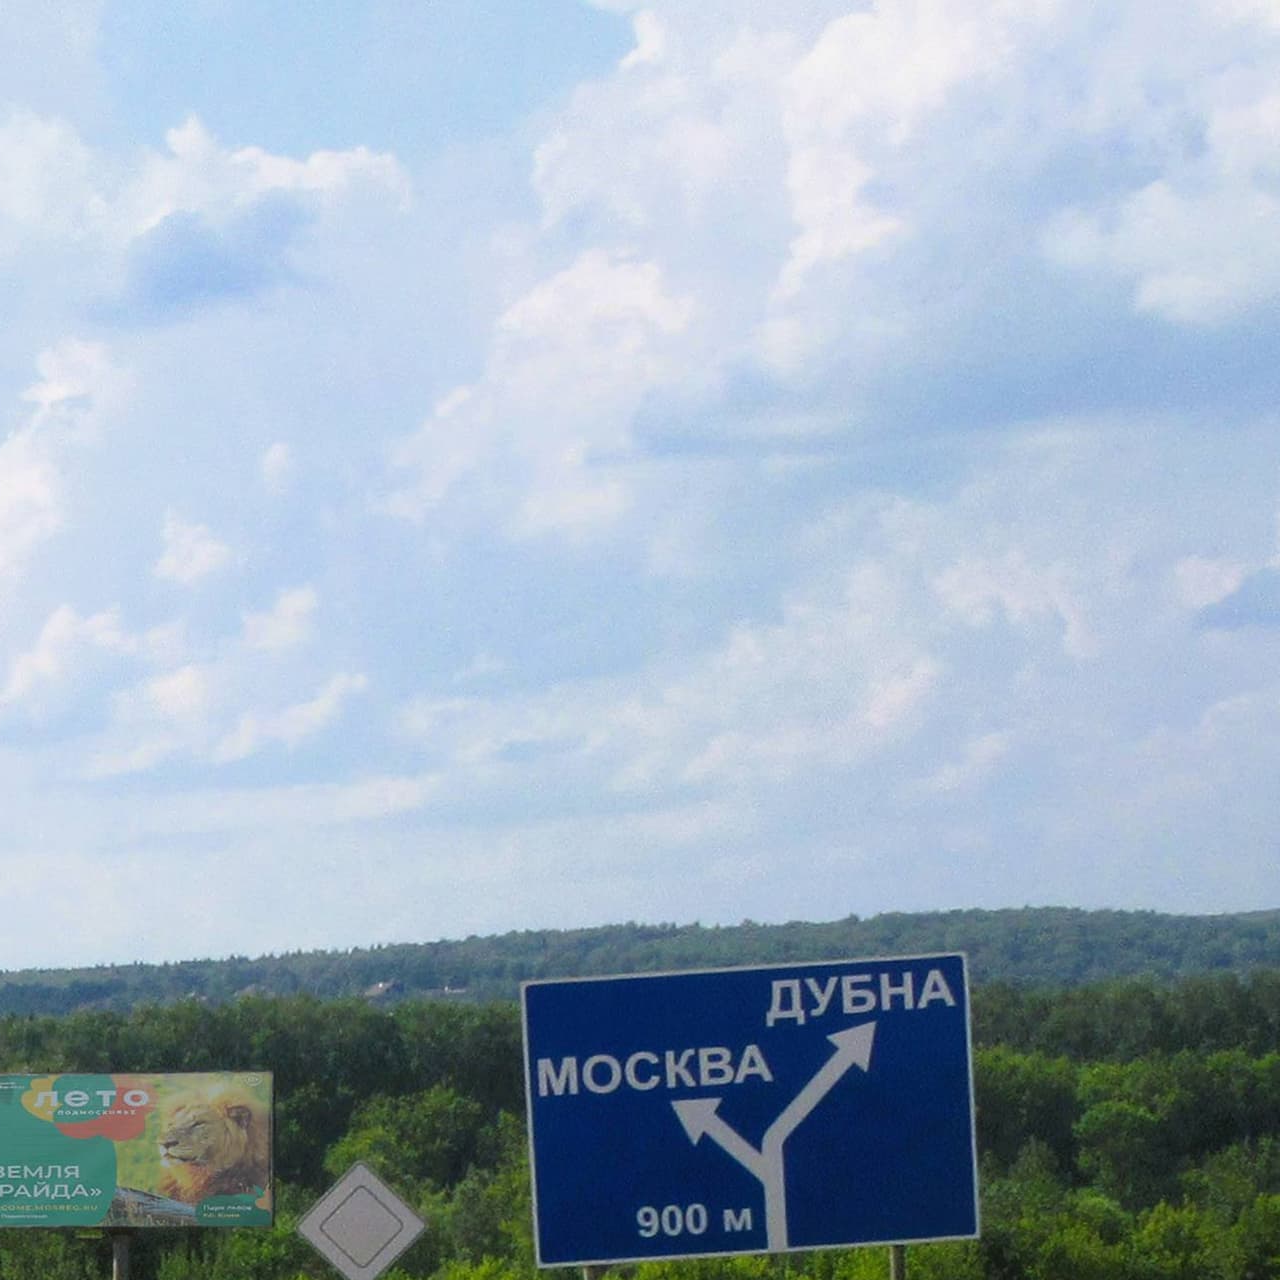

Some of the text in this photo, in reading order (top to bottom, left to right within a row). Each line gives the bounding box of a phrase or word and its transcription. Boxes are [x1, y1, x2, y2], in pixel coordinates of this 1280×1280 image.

[766, 969, 957, 1027] ДУБНА
[536, 1044, 774, 1097] МОСКВА
[636, 1203, 708, 1238] 900
